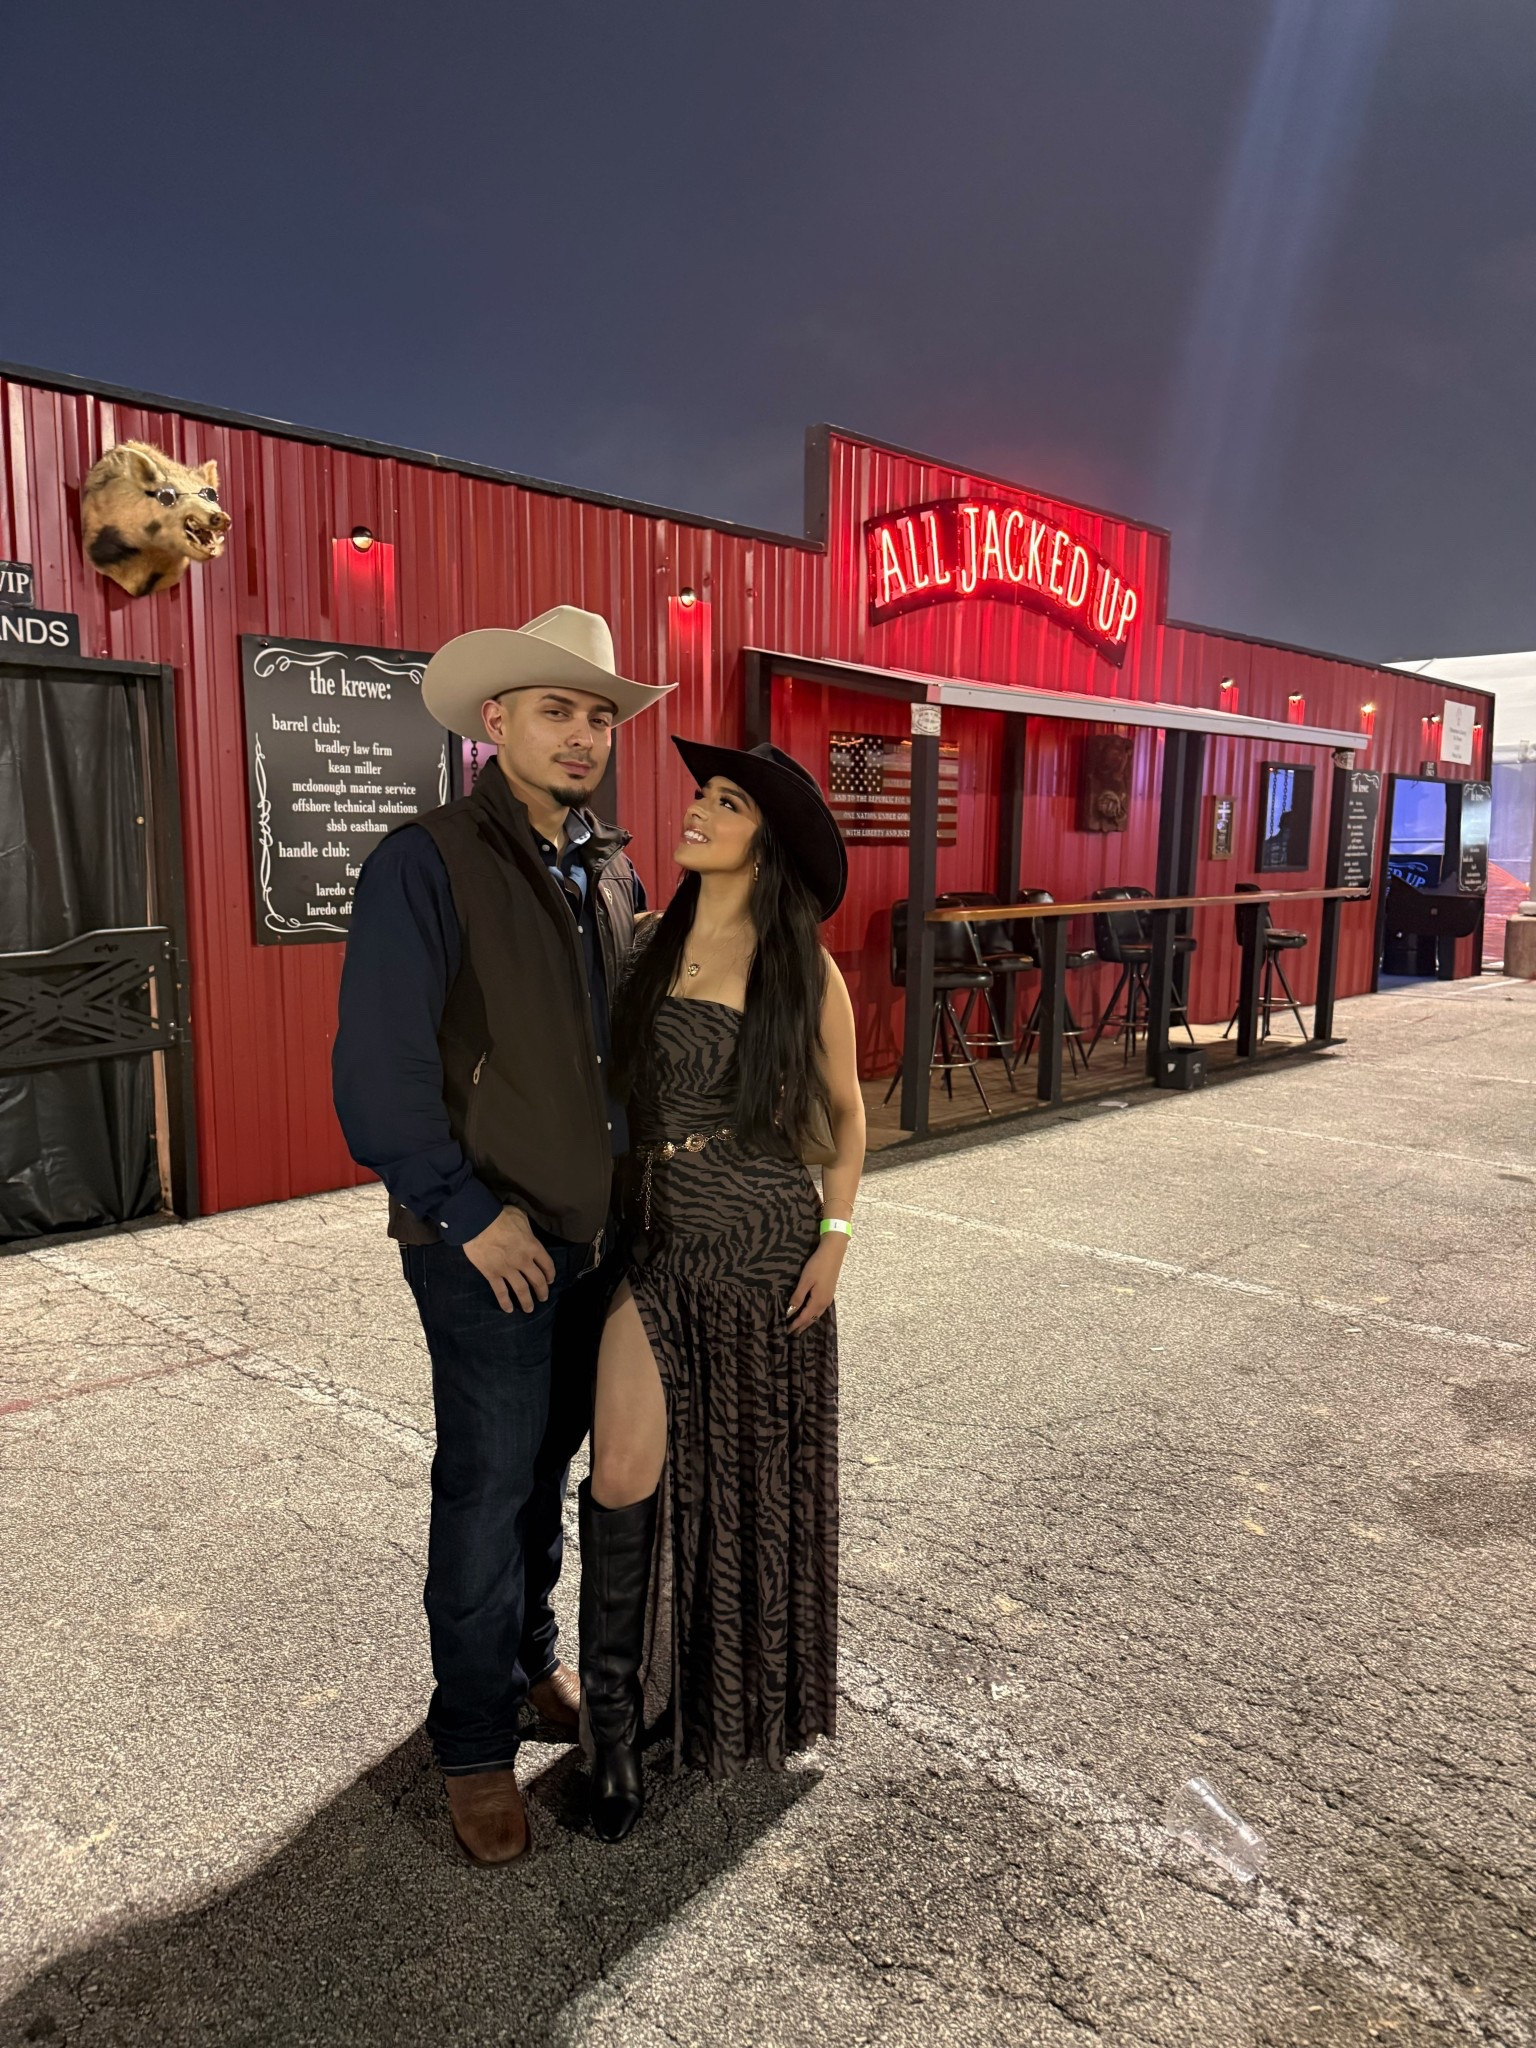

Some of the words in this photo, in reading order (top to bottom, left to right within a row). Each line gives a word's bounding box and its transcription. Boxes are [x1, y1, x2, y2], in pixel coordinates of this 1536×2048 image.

[875, 510, 950, 608] ALL
[956, 503, 1089, 608] JACKED
[1093, 564, 1137, 644] UP
[0, 615, 70, 647] NDS
[309, 666, 335, 695] the
[340, 669, 392, 700] krewe:
[271, 714, 309, 733] barrel
[312, 716, 341, 734] club:
[314, 739, 351, 757] bradley
[353, 741, 370, 755] law
[372, 742, 393, 756] firm
[328, 759, 351, 774] kean
[354, 761, 382, 775] miller
[292, 778, 347, 795] mcdonough
[350, 781, 382, 794] marine
[385, 782, 417, 795] service
[292, 799, 331, 813] offshore
[334, 800, 376, 814] technical
[378, 800, 418, 814] solutions
[834, 794, 847, 802] AND
[868, 795, 894, 804] REPUBLIC
[878, 812, 896, 820] UNDER
[326, 819, 348, 832] sbsb
[350, 820, 388, 832] eastham
[845, 829, 861, 837] WITH
[862, 829, 884, 837] LIBERTY
[886, 829, 895, 837] AND
[895, 829, 911, 837] JUST
[278, 841, 319, 858] handle
[322, 842, 351, 858] club:
[345, 863, 363, 880] fag
[315, 881, 346, 897] laredo
[306, 901, 337, 916] laredo
[339, 901, 354, 915] off
